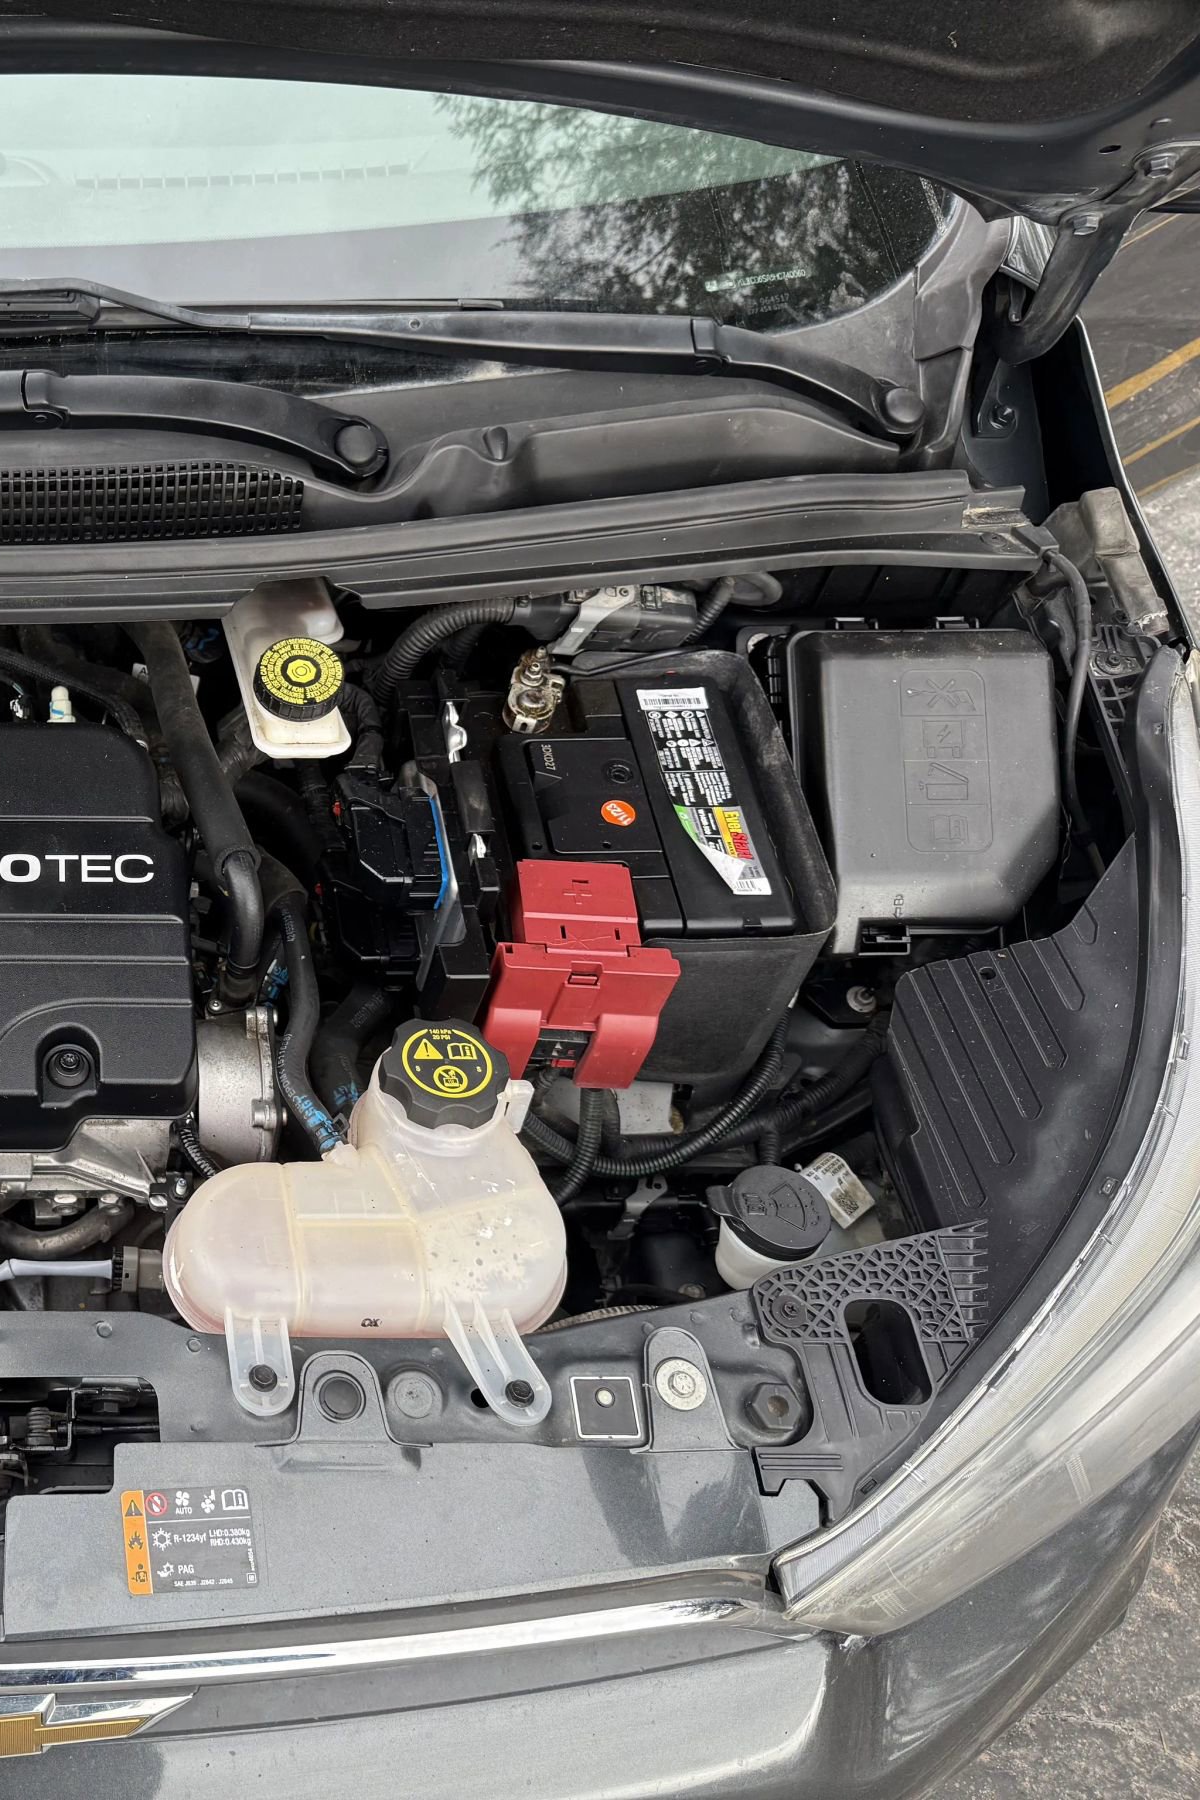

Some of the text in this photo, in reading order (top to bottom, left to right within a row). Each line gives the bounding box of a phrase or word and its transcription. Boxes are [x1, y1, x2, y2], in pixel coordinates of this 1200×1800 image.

[723, 810, 754, 860] EverStart
[175, 1507, 193, 1515] AUTO
[173, 1532, 207, 1544] R-1234yf
[177, 1564, 195, 1575] PAG
